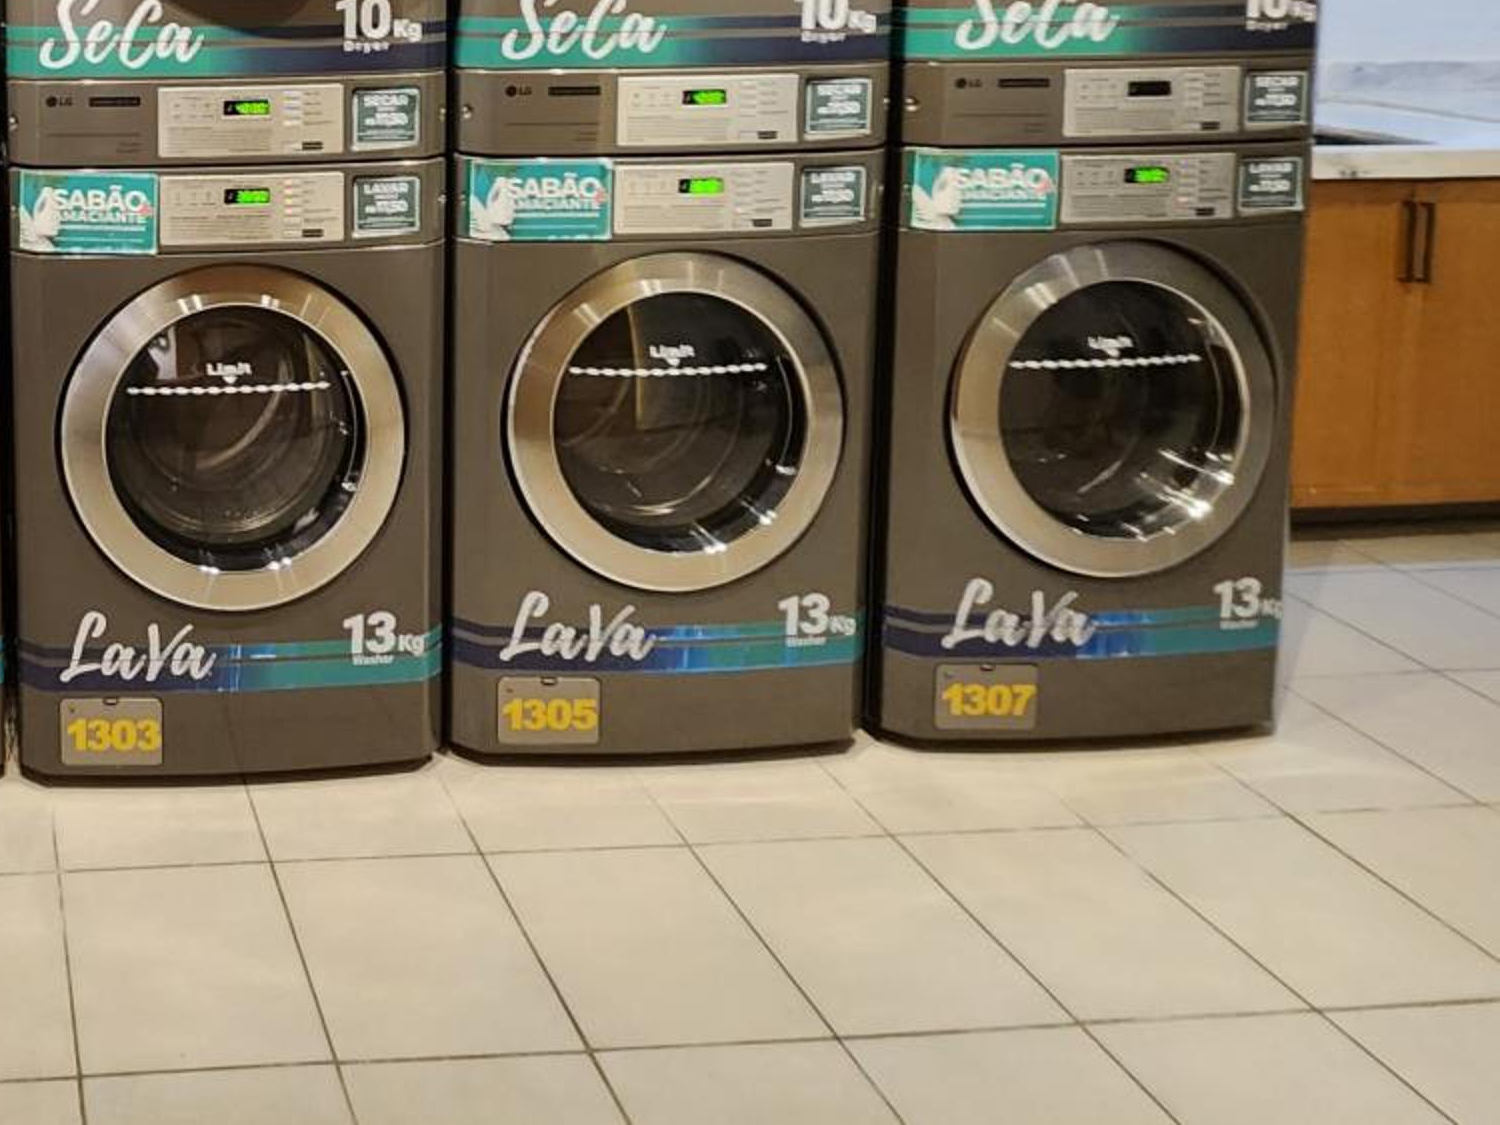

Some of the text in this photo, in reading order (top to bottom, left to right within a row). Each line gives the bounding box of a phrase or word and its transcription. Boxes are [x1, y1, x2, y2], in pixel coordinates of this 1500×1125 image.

[393, 18, 422, 42] Kg
[53, 185, 148, 211] SABÃO
[511, 172, 604, 198] SABÃO
[778, 592, 830, 636] 13
[940, 578, 1099, 649] LaVa
[1213, 577, 1262, 619] 13
[343, 611, 425, 656] 13 Kg
[499, 591, 658, 662] LaVa
[59, 611, 216, 683] LaVa
[503, 698, 598, 732] 1305
[942, 682, 1038, 716] 1307
[67, 718, 160, 752] 1303
